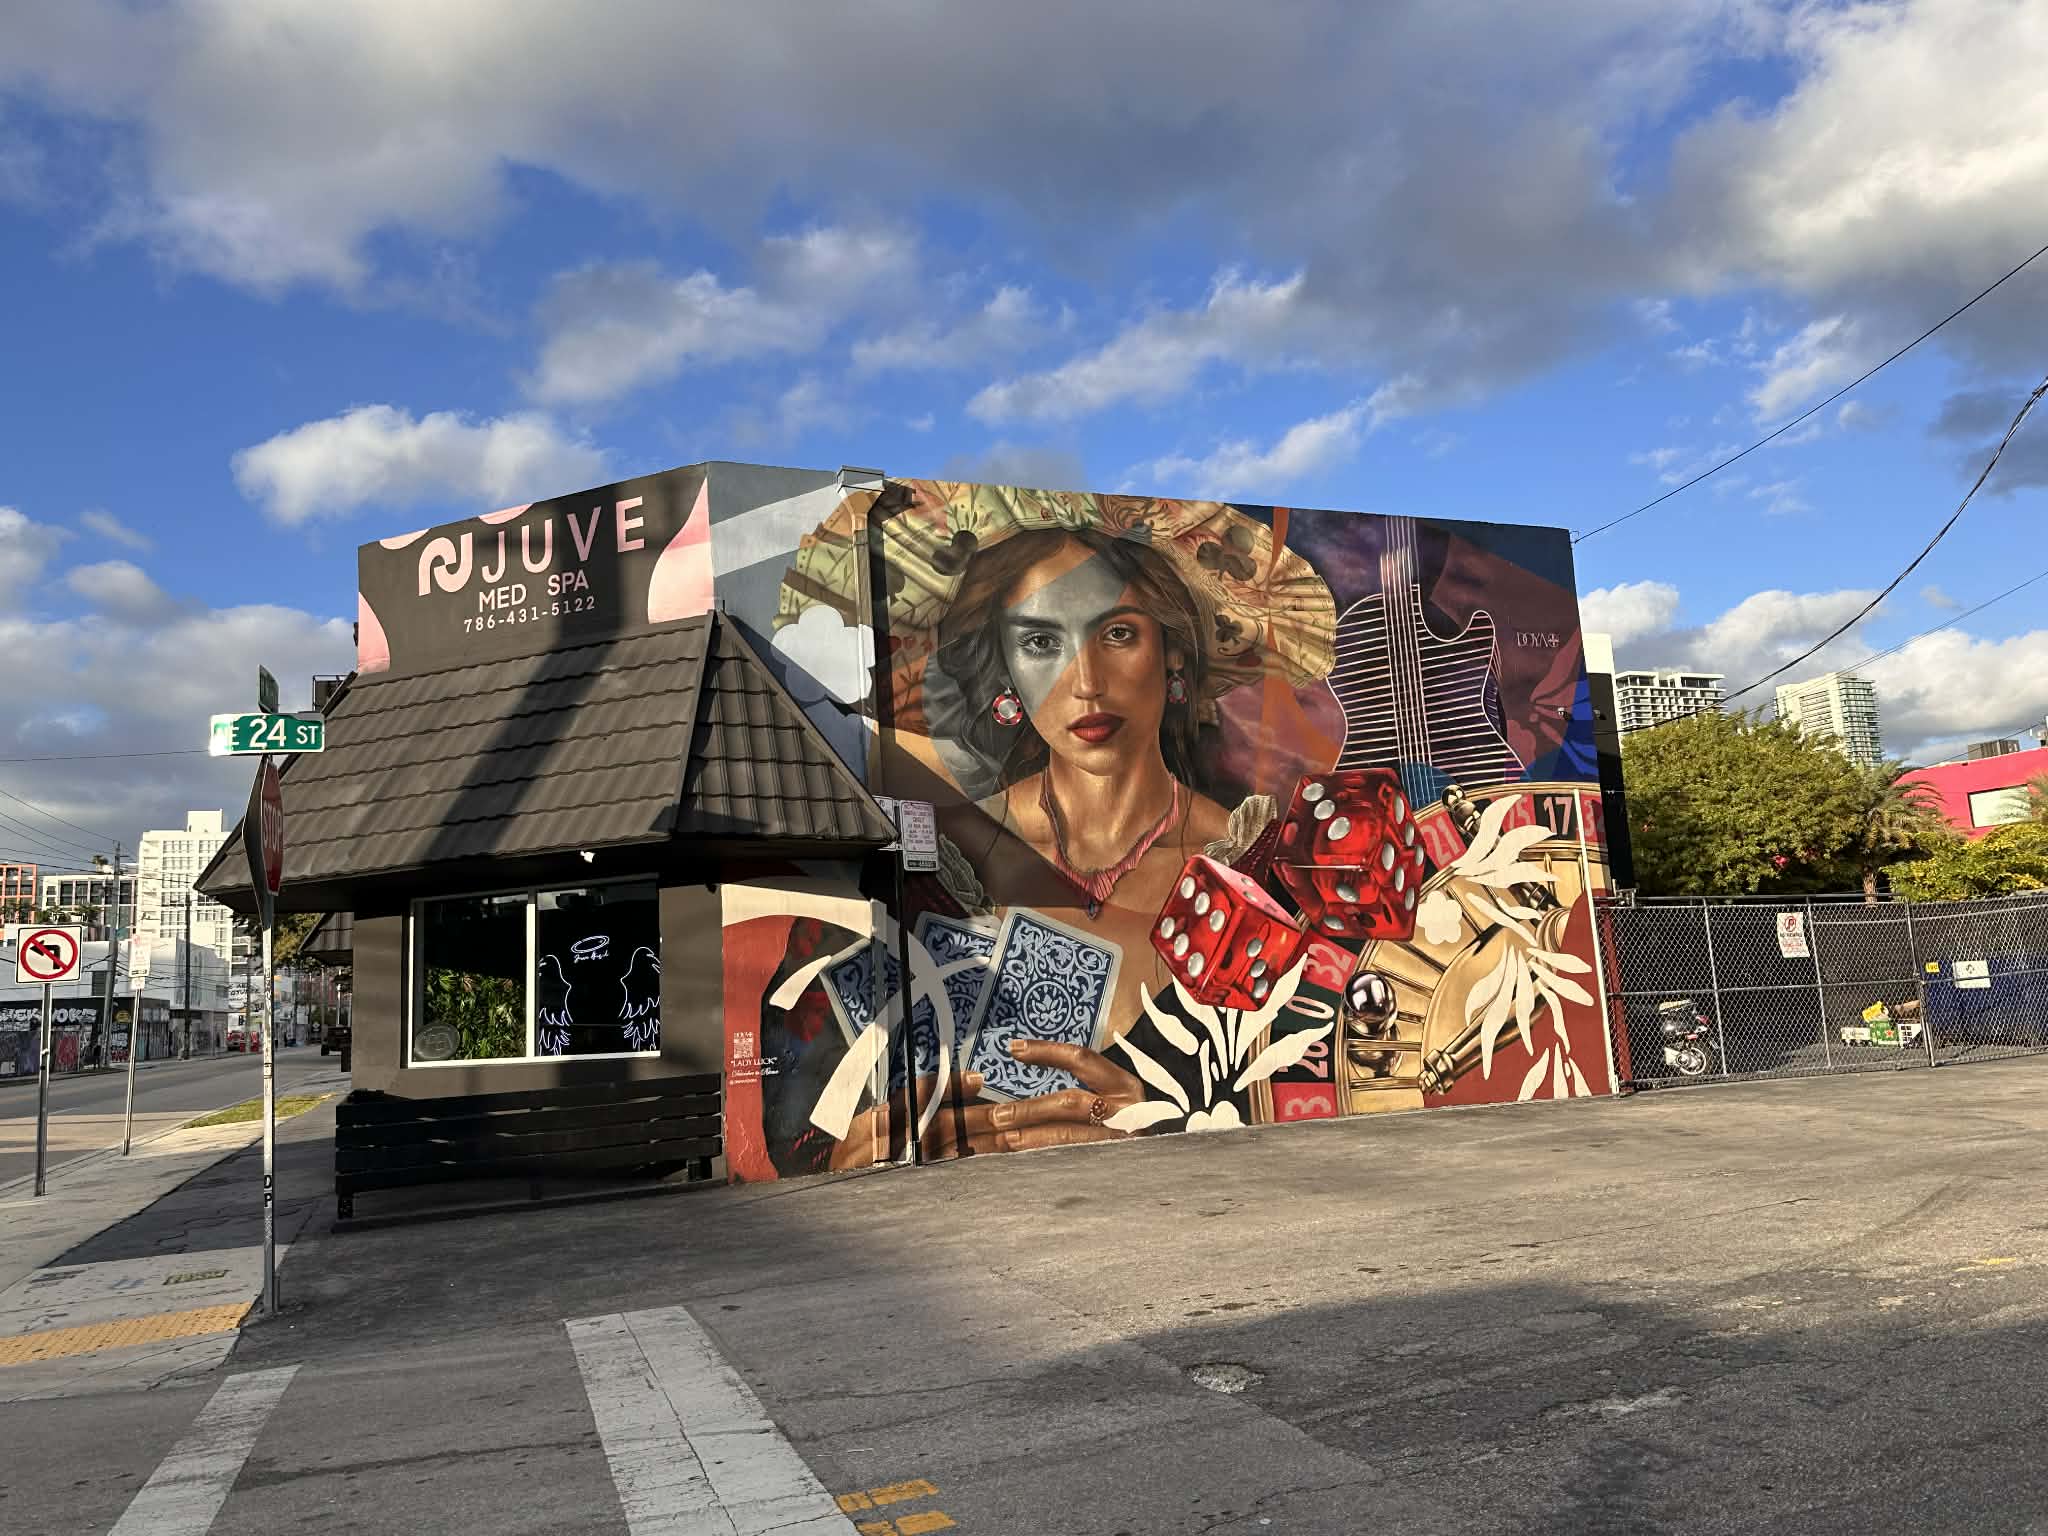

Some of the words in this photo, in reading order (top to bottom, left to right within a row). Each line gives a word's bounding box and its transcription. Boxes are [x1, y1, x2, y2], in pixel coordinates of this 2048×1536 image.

[479, 583, 527, 613] MED
[547, 569, 589, 596] SPA
[463, 595, 595, 633] 786-431-5122
[248, 718, 287, 748] 24
[296, 725, 319, 744] ST
[1543, 796, 1573, 836] 17
[1420, 815, 1460, 865] 21
[1304, 943, 1351, 986] 32
